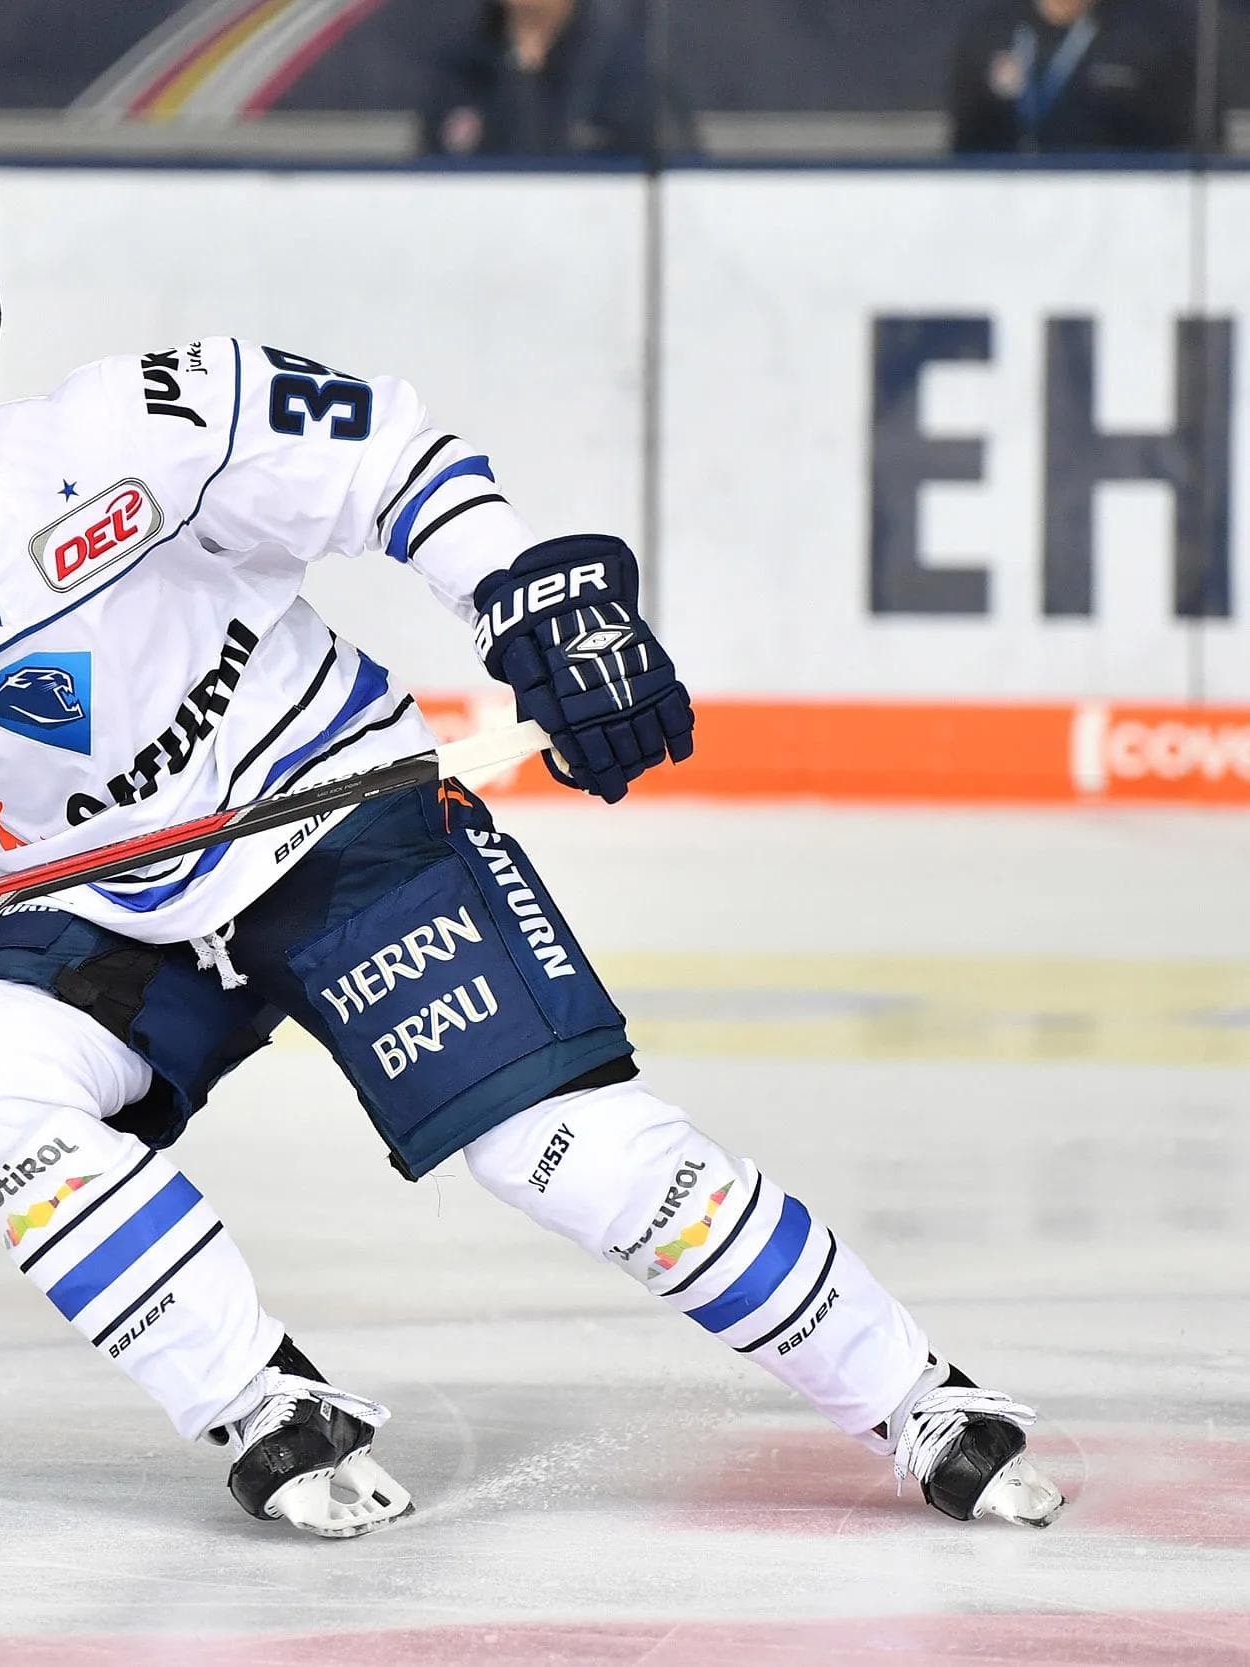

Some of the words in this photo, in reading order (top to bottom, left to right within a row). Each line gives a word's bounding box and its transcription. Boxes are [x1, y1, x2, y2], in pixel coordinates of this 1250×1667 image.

[868, 312, 1236, 617] EH
[54, 489, 144, 582] DEL
[465, 828, 576, 980] SATURN
[320, 905, 483, 1024] HERRN
[371, 975, 499, 1080] BRÄU
[109, 1292, 176, 1359] BAUER
[777, 1287, 840, 1357] BAUER
